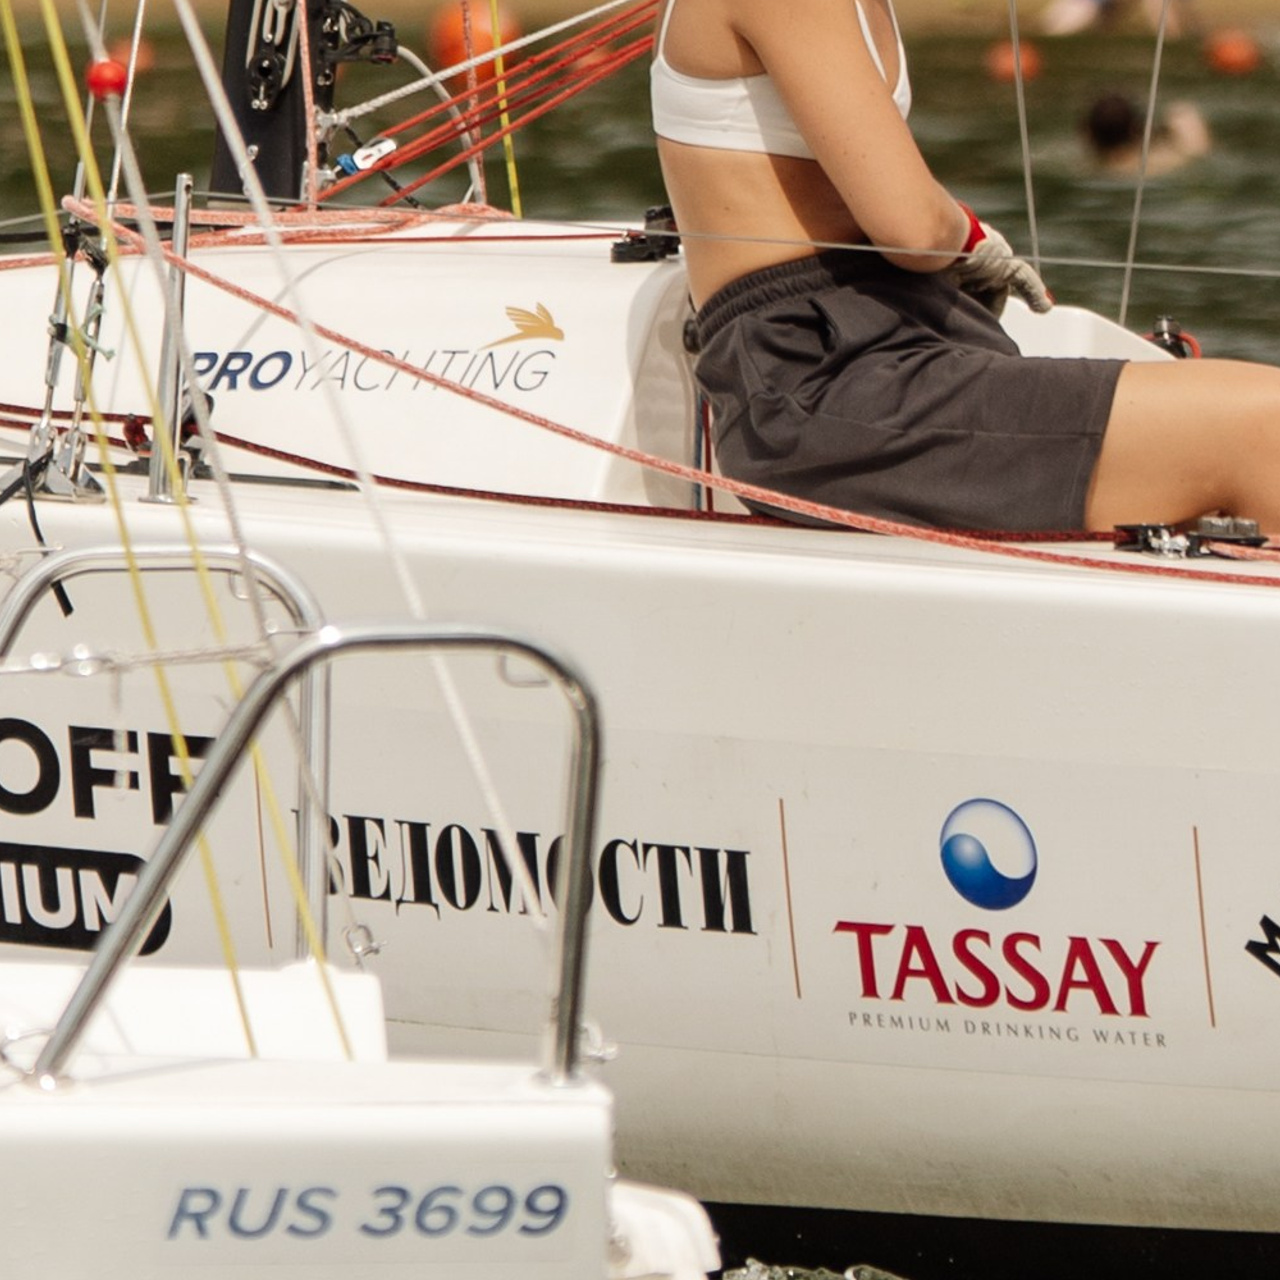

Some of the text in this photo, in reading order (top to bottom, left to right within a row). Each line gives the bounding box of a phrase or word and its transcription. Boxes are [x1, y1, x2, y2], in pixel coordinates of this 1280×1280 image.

[181, 350, 556, 392] PROYACHTING
[833, 920, 1162, 1018] TASSAY
[848, 1011, 1167, 1048] PREMIUM DRINKING WATER
[166, 1184, 570, 1241] RUS 3699
